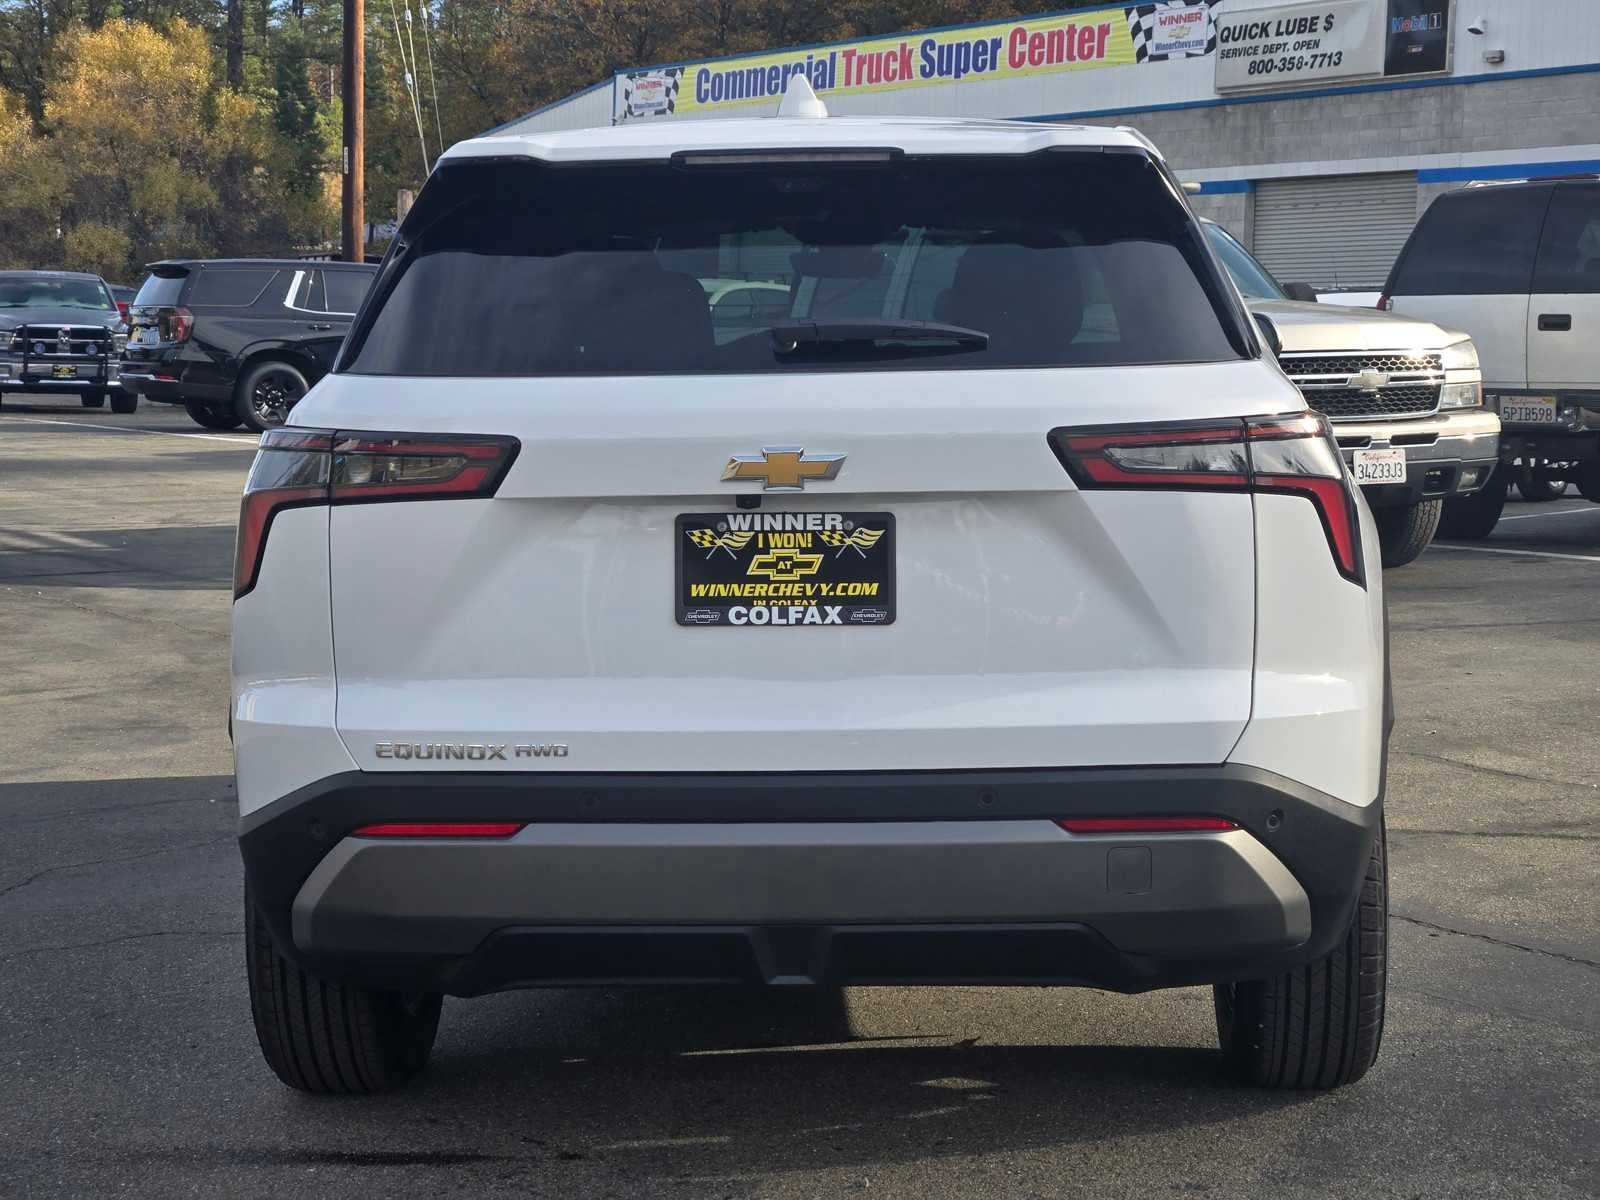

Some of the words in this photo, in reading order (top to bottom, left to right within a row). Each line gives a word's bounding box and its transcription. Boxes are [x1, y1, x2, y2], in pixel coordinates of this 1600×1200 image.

[1159, 11, 1202, 26] WINNER
[1220, 21, 1272, 43] QUICK
[1275, 16, 1320, 37] LUBE
[1323, 13, 1334, 32] $
[842, 42, 914, 87] Truck
[920, 38, 1002, 79] Super
[1008, 22, 1111, 69] Center
[1220, 45, 1259, 59] SERVICE
[1293, 39, 1320, 51] OPEN
[1248, 51, 1343, 75] 800-358-7713
[1358, 461, 1403, 479] 34233J3
[727, 513, 843, 531] WINNER
[757, 532, 763, 548] I
[768, 532, 812, 548] WON!
[777, 561, 793, 570] AT
[690, 582, 879, 597] WINNERCHEVY.COM
[728, 605, 843, 625] COLFAX
[375, 742, 508, 761] EQUINOX
